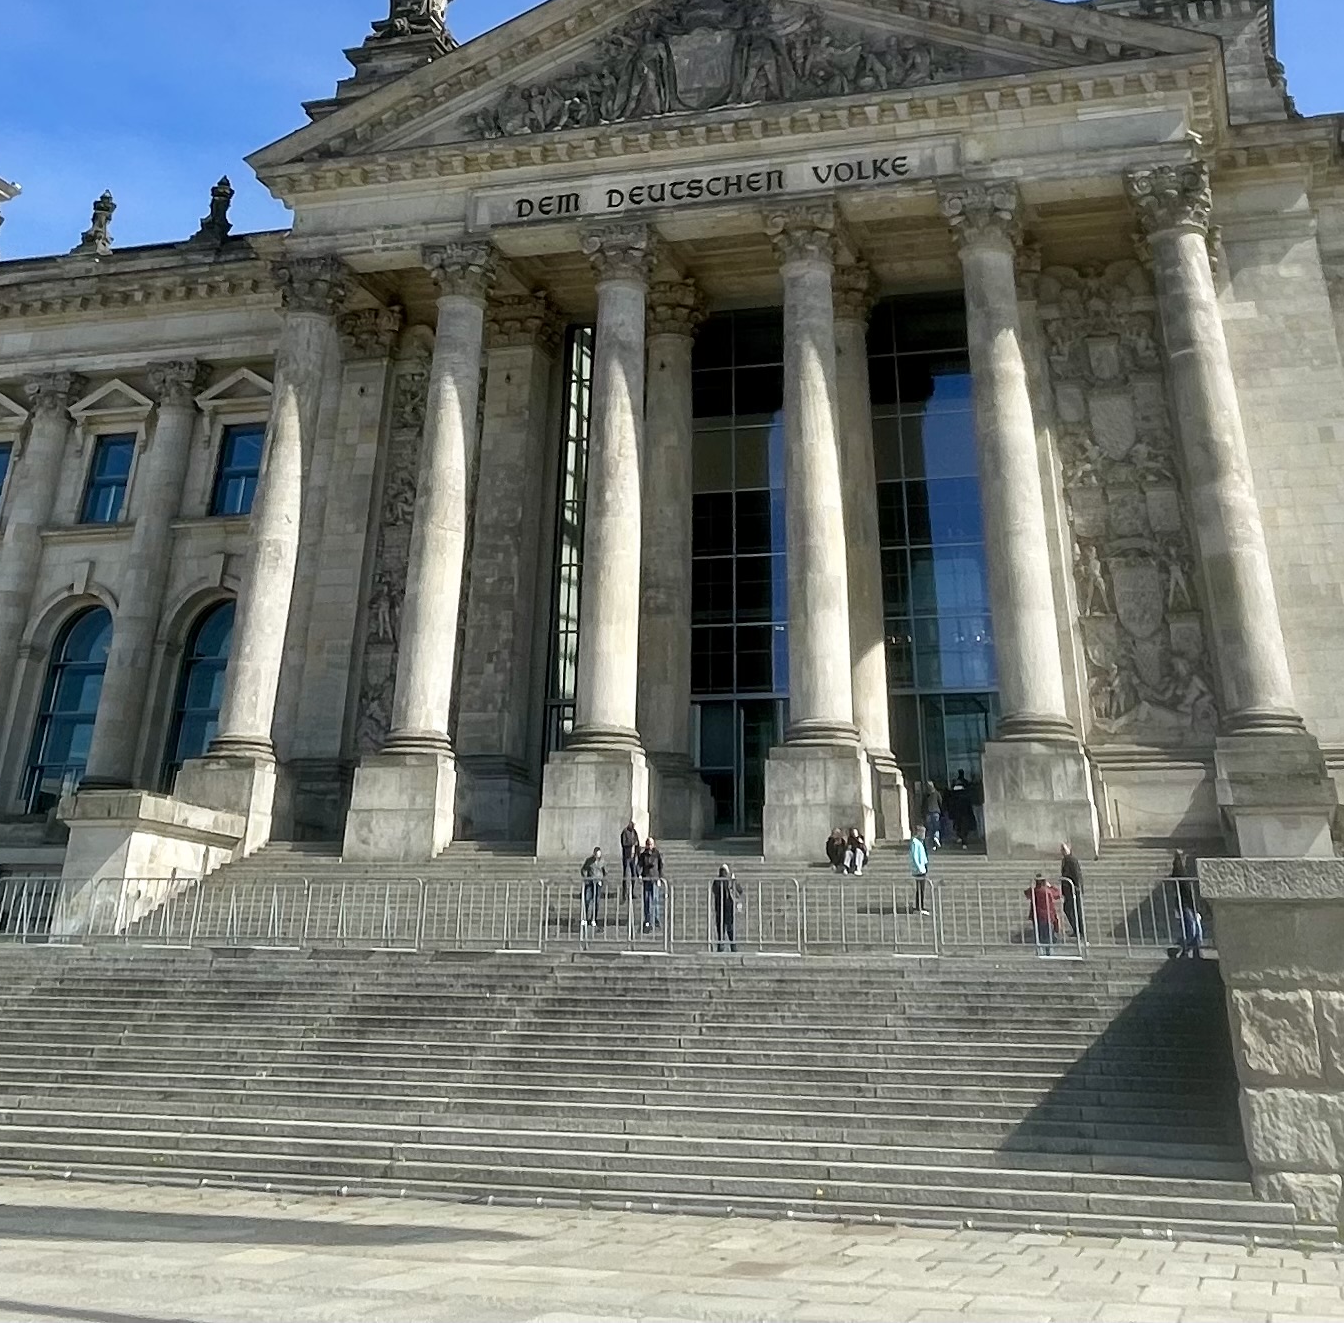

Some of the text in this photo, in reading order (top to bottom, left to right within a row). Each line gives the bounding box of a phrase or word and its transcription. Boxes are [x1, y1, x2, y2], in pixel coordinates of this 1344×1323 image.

[516, 156, 910, 218] DEM DEUTSCHEN VOLKE
